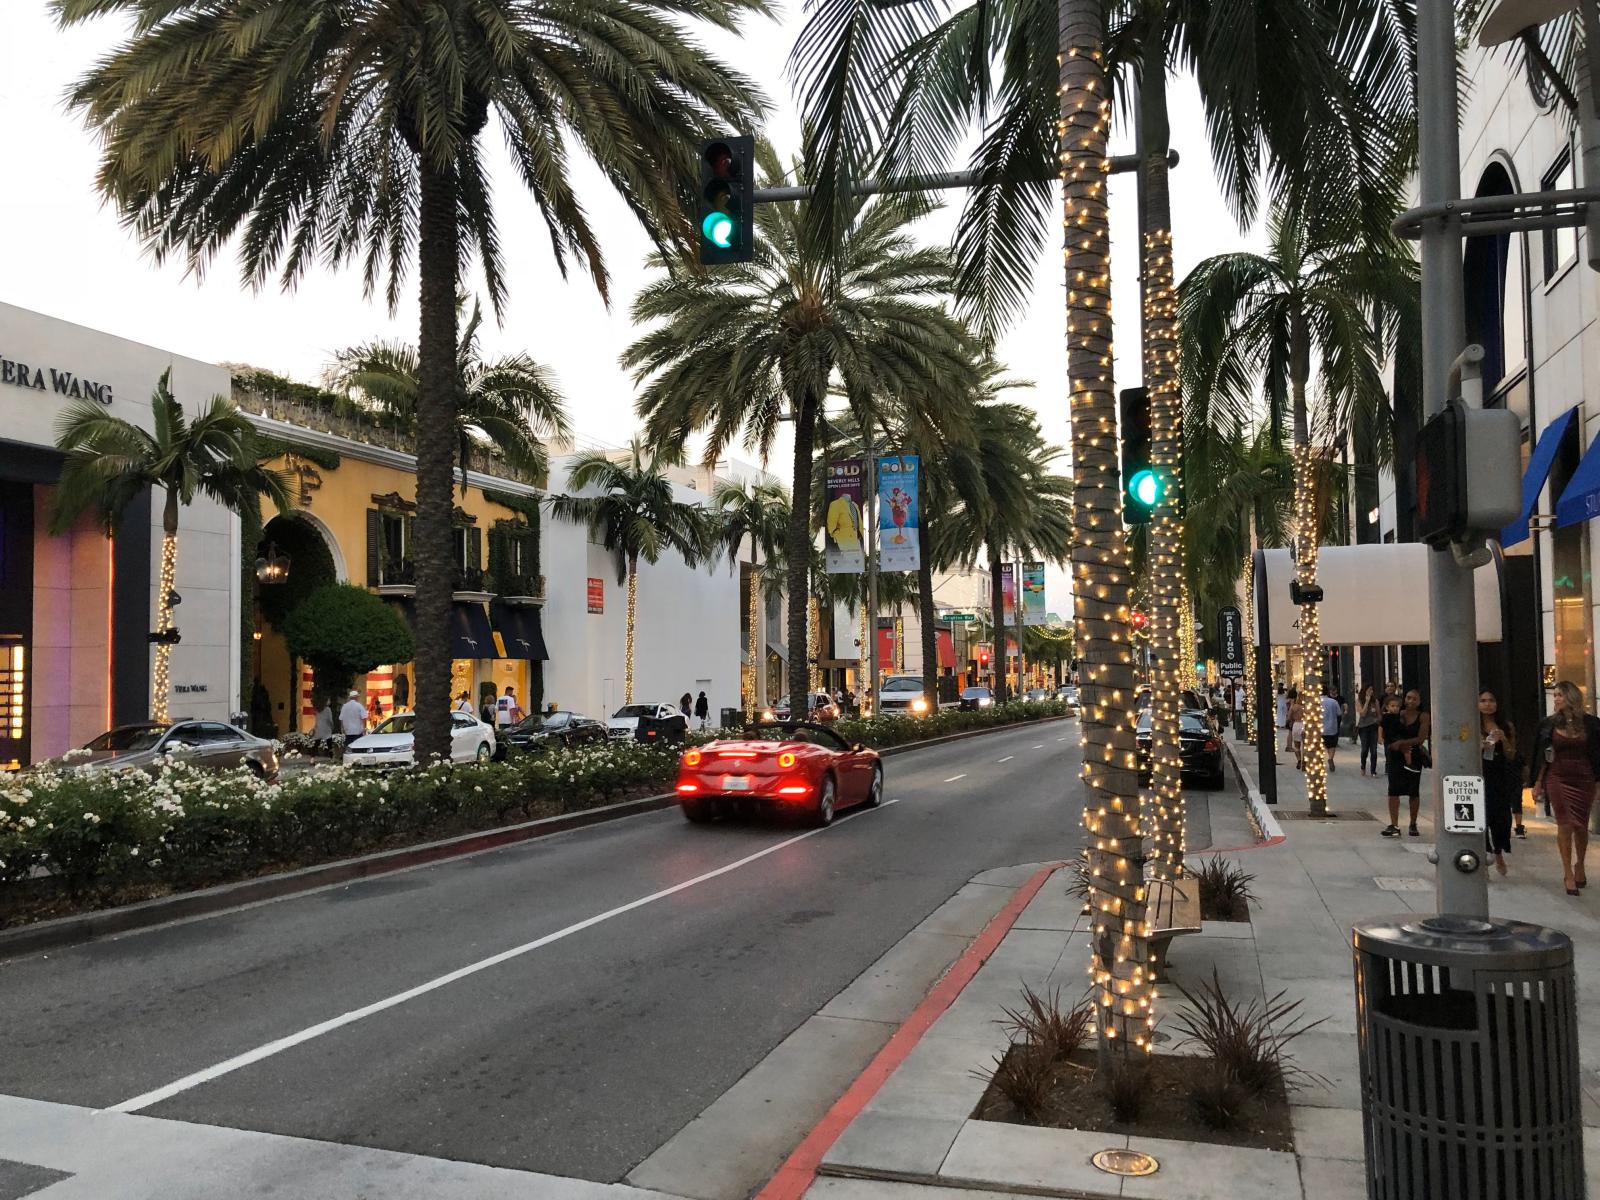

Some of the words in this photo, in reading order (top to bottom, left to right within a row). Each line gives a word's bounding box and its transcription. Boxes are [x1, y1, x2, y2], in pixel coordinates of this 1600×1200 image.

[0, 355, 46, 390] ERA
[50, 368, 113, 404] WANG
[827, 465, 860, 477] BOLD
[1226, 616, 1234, 652] PARKING
[1448, 787, 1479, 795] BUTTON
